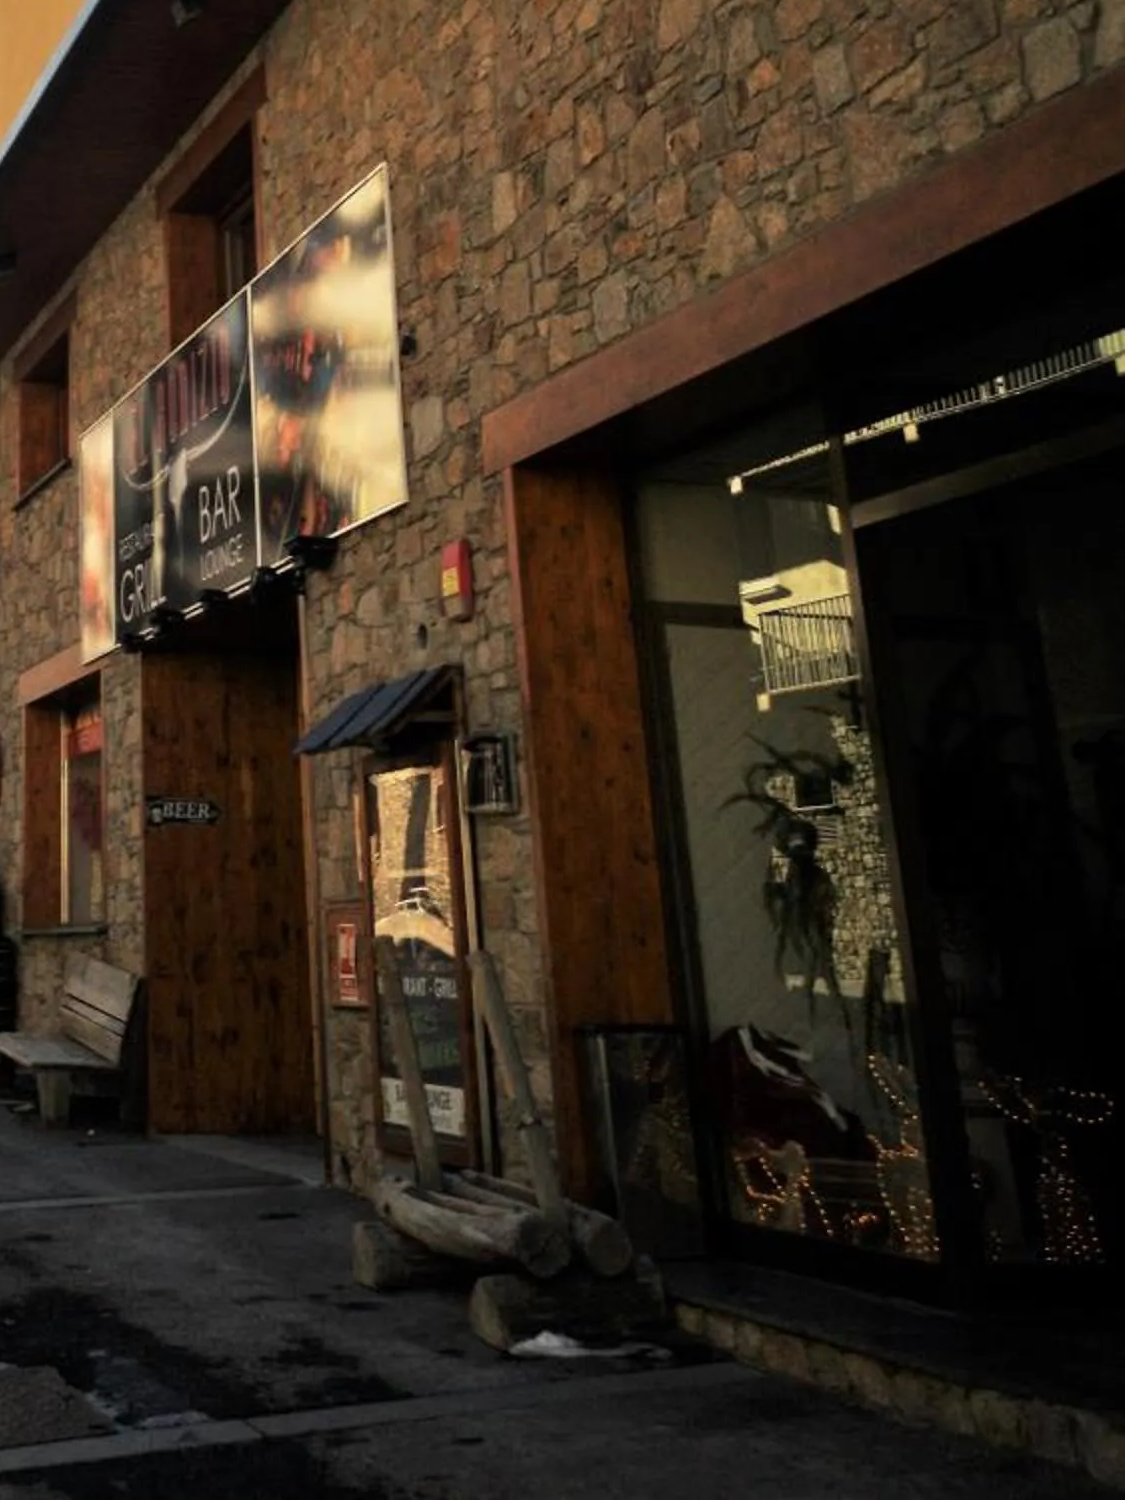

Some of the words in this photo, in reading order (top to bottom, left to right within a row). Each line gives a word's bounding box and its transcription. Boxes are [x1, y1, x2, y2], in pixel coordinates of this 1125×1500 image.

[199, 465, 242, 545] BAR
[200, 533, 244, 582] LOUNGE
[162, 801, 210, 819] BEER
